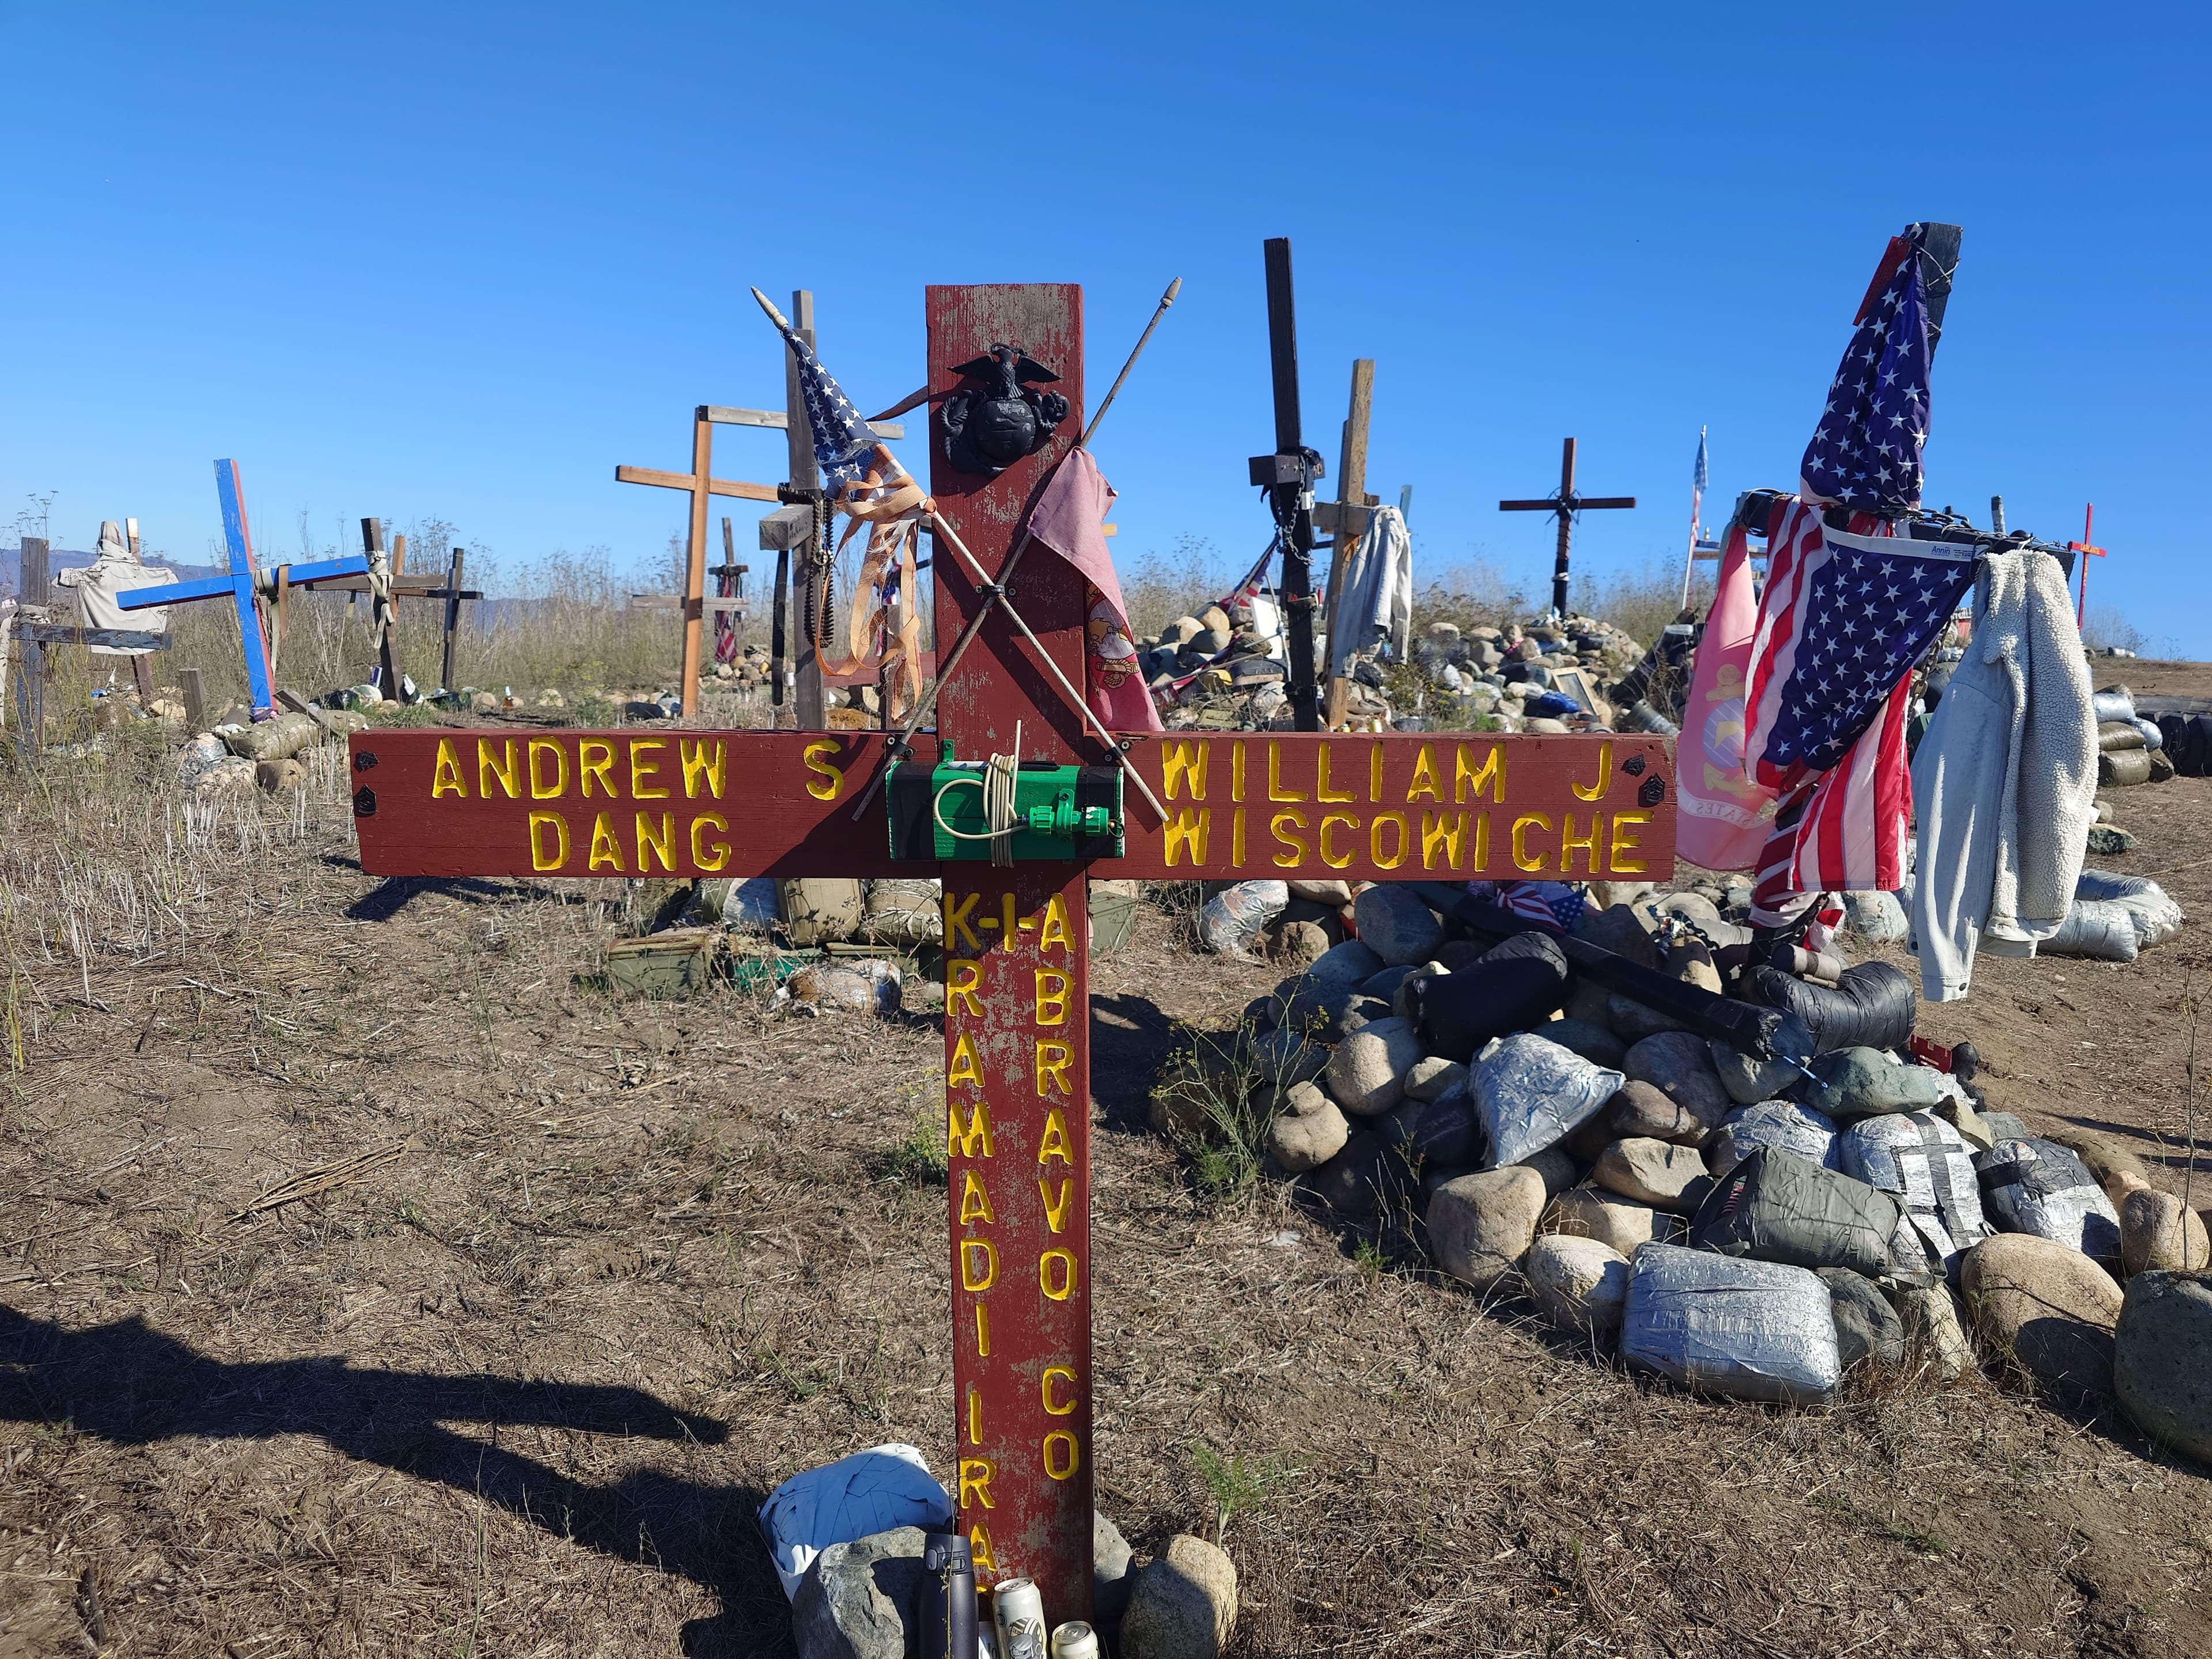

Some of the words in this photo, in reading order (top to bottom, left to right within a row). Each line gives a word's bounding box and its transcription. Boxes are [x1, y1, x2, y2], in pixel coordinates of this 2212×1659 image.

[1931, 546, 1950, 555] Annin
[431, 736, 728, 799] ANDREW
[804, 739, 843, 801] S
[1161, 737, 1506, 804] WILLIAM
[1571, 741, 1612, 802] J
[529, 810, 730, 872] DANG
[1163, 806, 1655, 873] WISCOWICHE
[944, 892, 1075, 953] K-I-A
[946, 959, 1000, 1357] RAMADI
[1035, 968, 1078, 1301] BRAVO
[1041, 1365, 1080, 1480] CO
[959, 1391, 998, 1601] IRA
